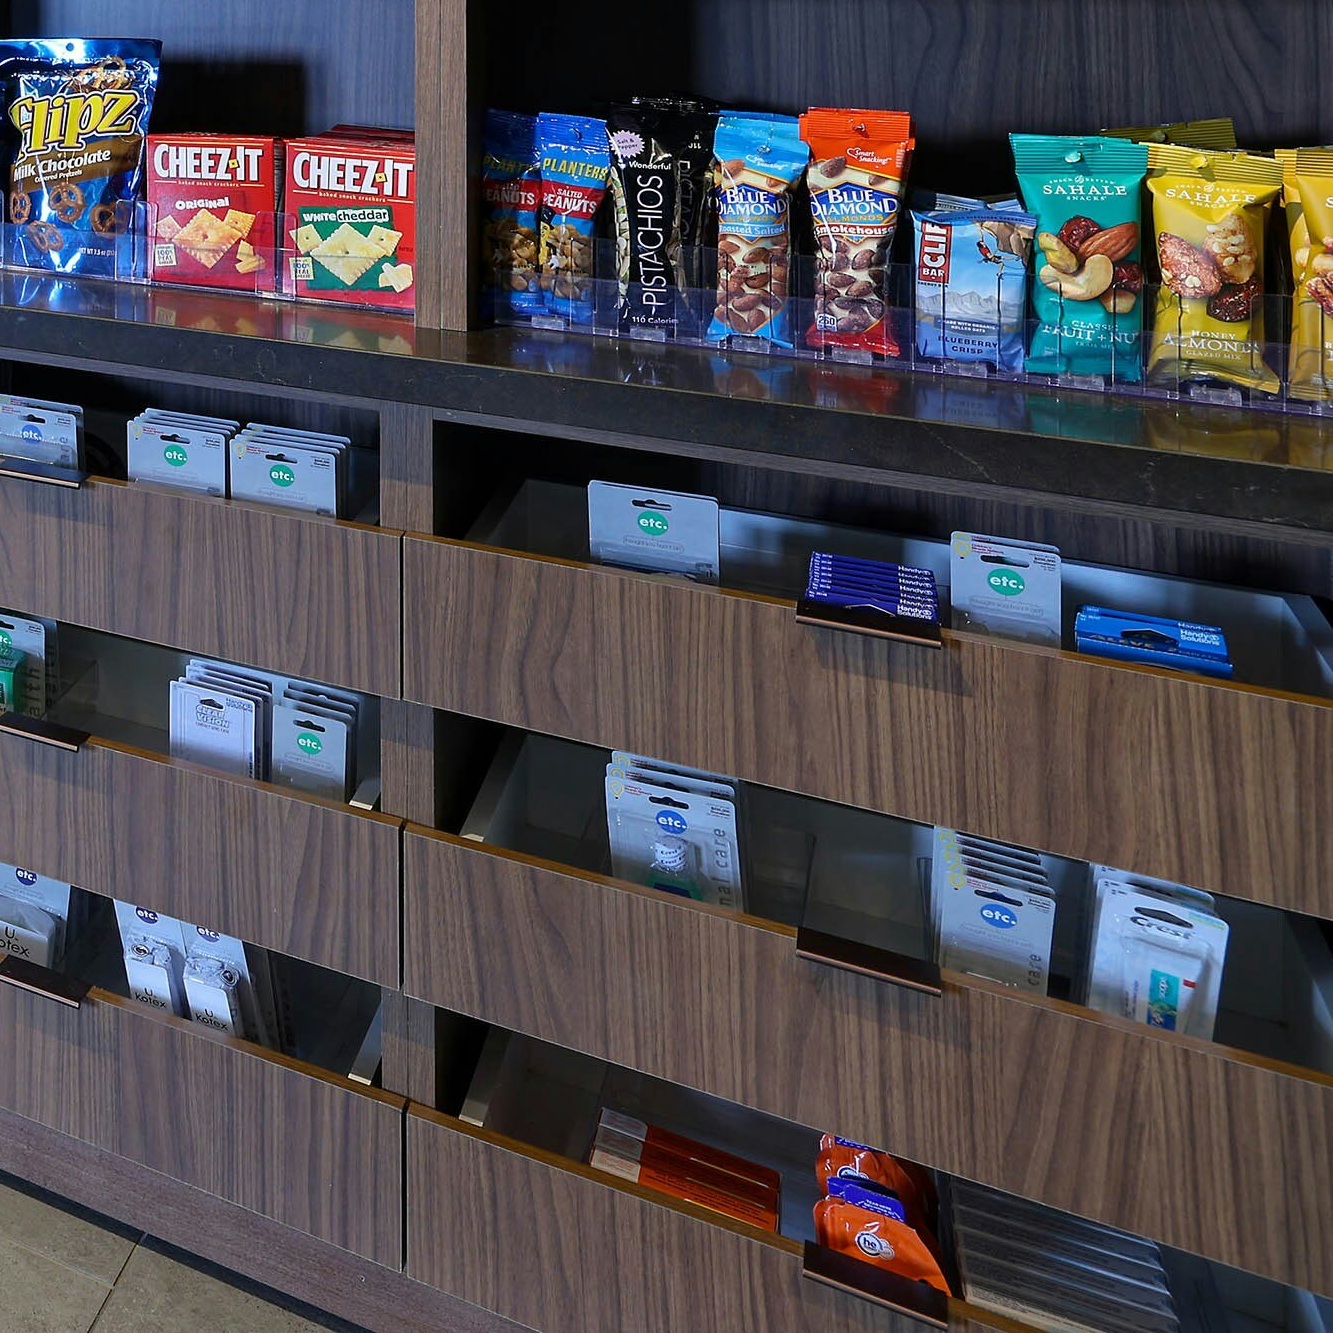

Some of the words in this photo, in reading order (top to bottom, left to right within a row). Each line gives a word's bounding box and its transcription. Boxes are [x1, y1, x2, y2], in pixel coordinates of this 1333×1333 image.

[8, 91, 140, 165] Flipz
[855, 150, 874, 159] Smart
[13, 162, 35, 182] Milk
[40, 149, 111, 173] Chocolate
[543, 158, 609, 181] PLANTERS
[629, 161, 671, 171] Wonderful
[557, 188, 583, 198] SALTED
[727, 189, 768, 204] BLUE
[828, 188, 875, 202] BLUE
[1043, 184, 1126, 196] SAHALE
[1165, 189, 1256, 205] SAHALE
[175, 197, 230, 211] ORIGINAL
[811, 198, 898, 215] DIAMOND
[302, 212, 336, 223] WHITE
[337, 209, 388, 222] cheddar
[816, 224, 895, 236] Smokehouse
[637, 175, 667, 306] PISTACHIOS
[923, 223, 948, 268] CLIF
[922, 268, 946, 278] BAR
[938, 335, 998, 350] BLUEBERRY
[1191, 330, 1235, 341] HONEY
[951, 345, 984, 356] CRISP
[714, 828, 728, 868] care
[981, 907, 1016, 924] etc.
